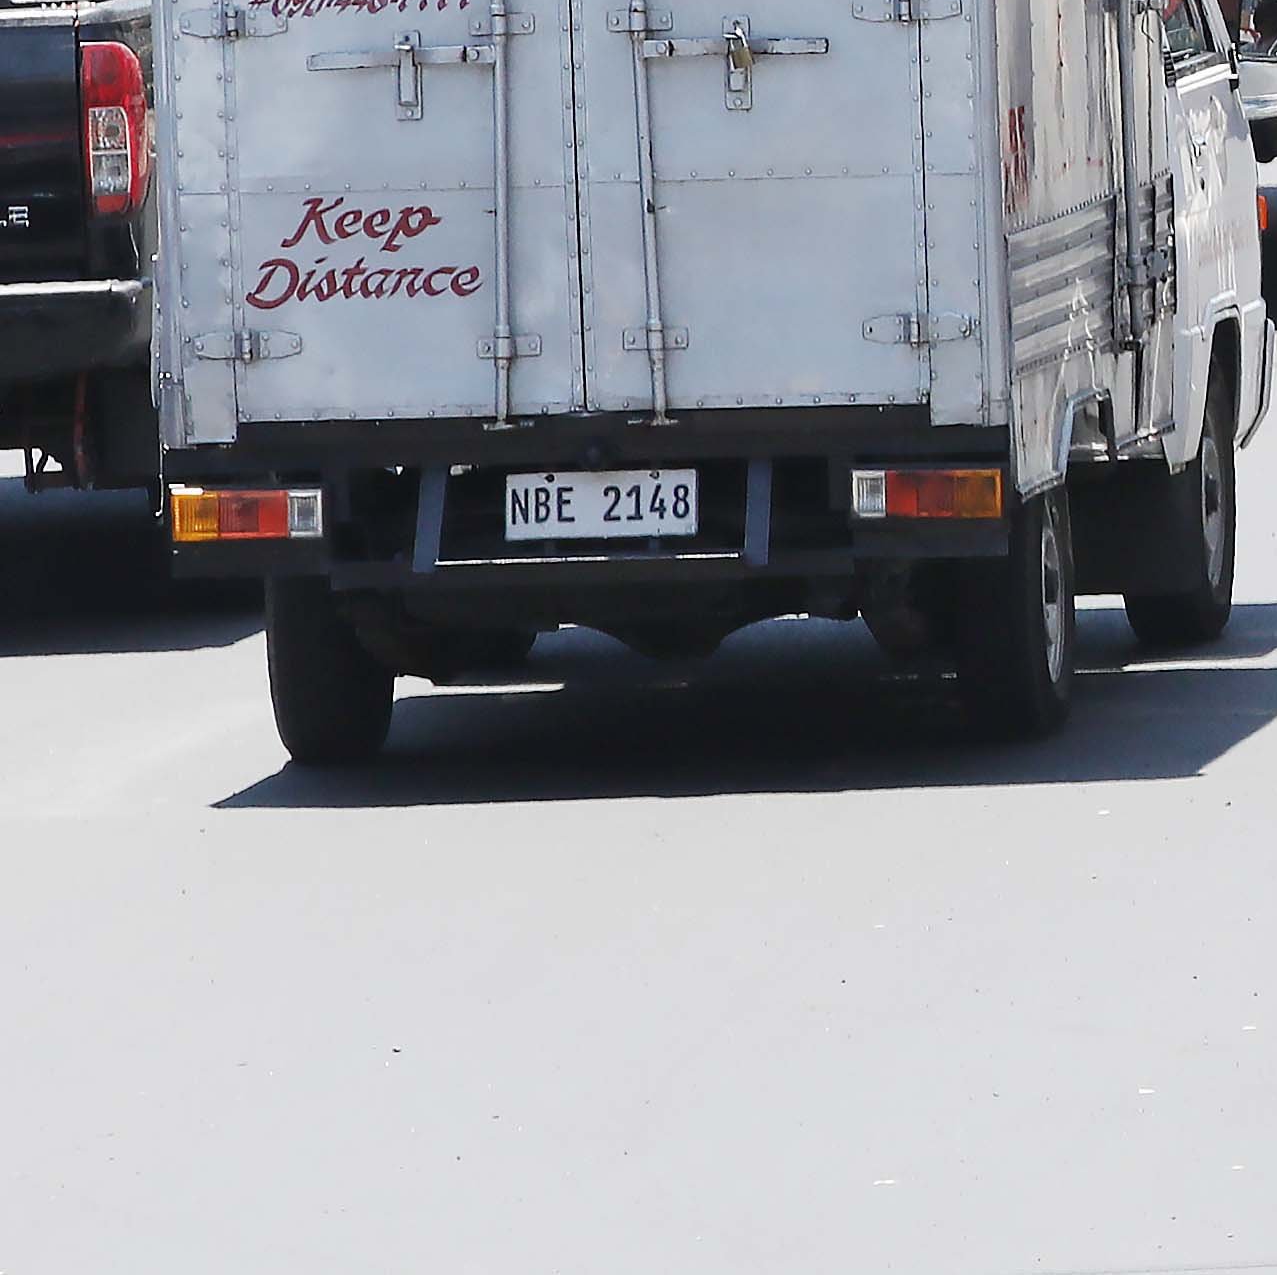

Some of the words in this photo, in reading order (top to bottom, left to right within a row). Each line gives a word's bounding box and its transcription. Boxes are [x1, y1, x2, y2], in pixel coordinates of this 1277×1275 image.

[281, 196, 442, 252] Keep
[246, 257, 483, 310] Distance
[511, 486, 575, 526] NBE
[603, 484, 690, 521] 2148
